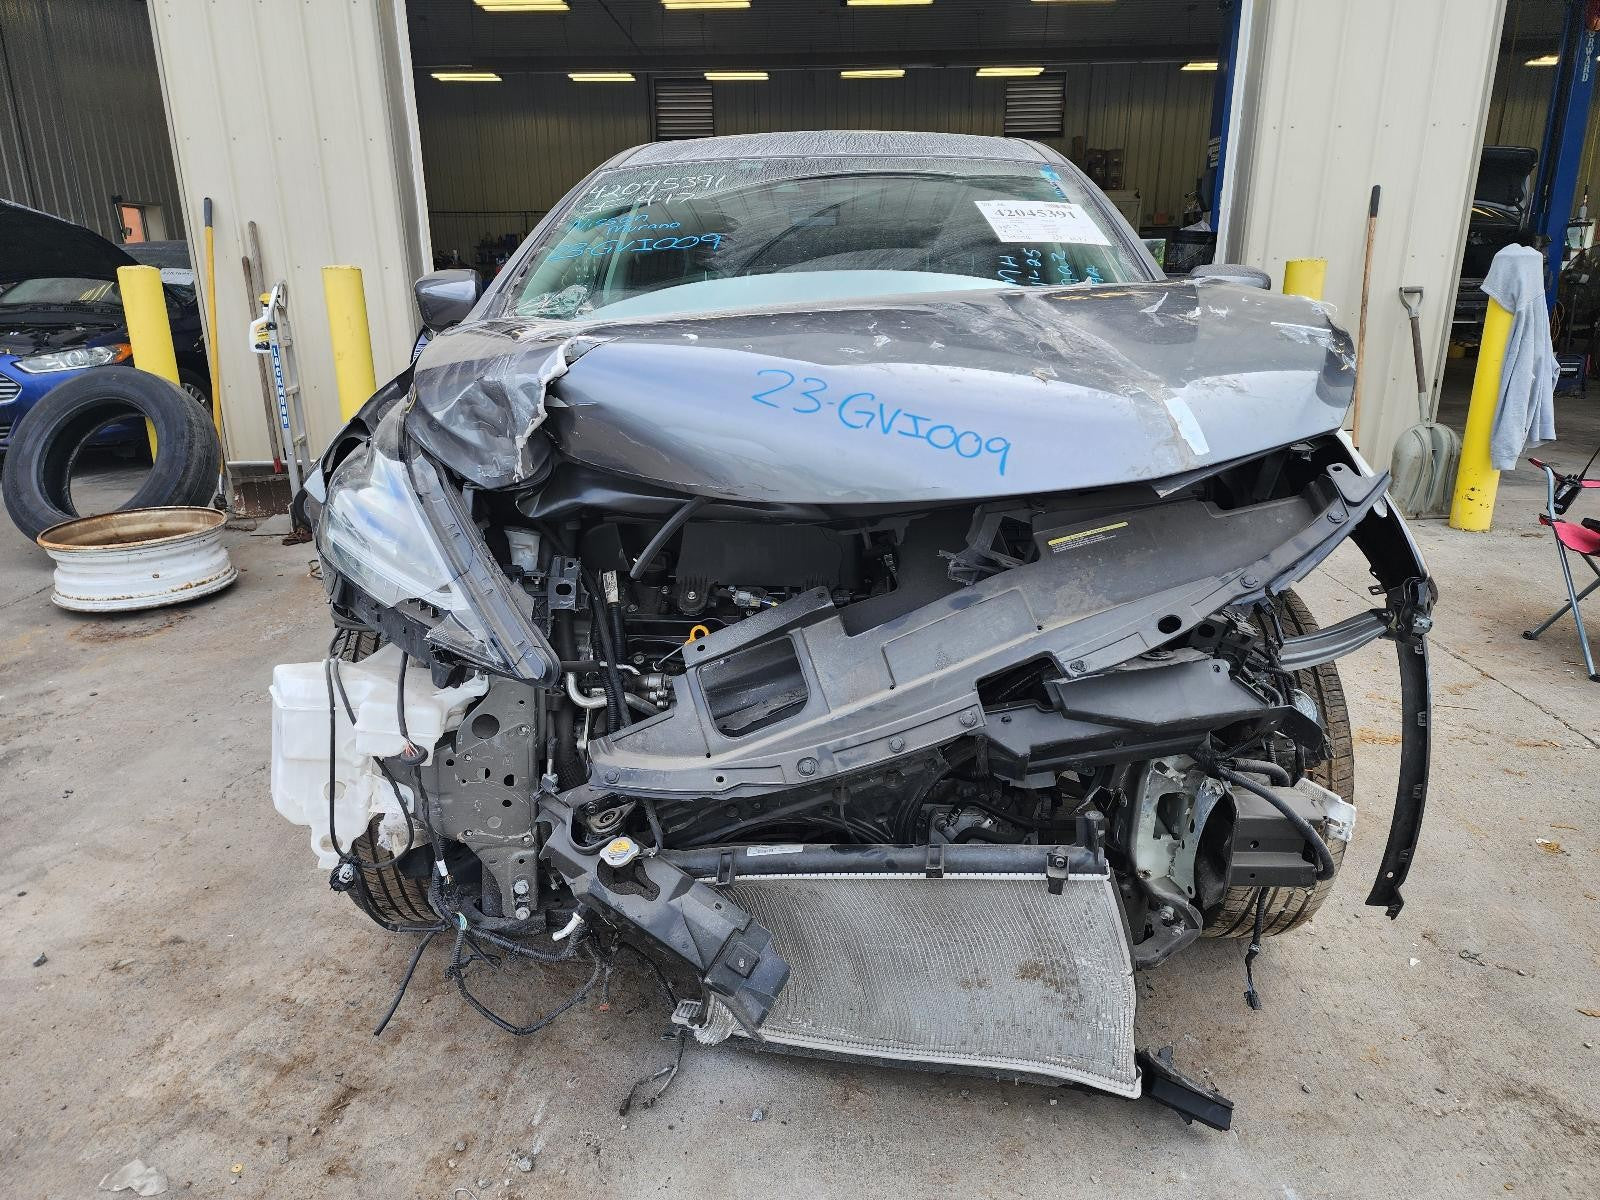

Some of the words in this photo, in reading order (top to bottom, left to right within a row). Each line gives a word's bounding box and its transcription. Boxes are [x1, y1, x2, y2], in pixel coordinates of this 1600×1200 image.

[590, 174, 727, 199] 42045391
[994, 208, 1077, 219] 42045391
[606, 221, 681, 235] Murano
[751, 369, 1012, 476] 23-GVI009
